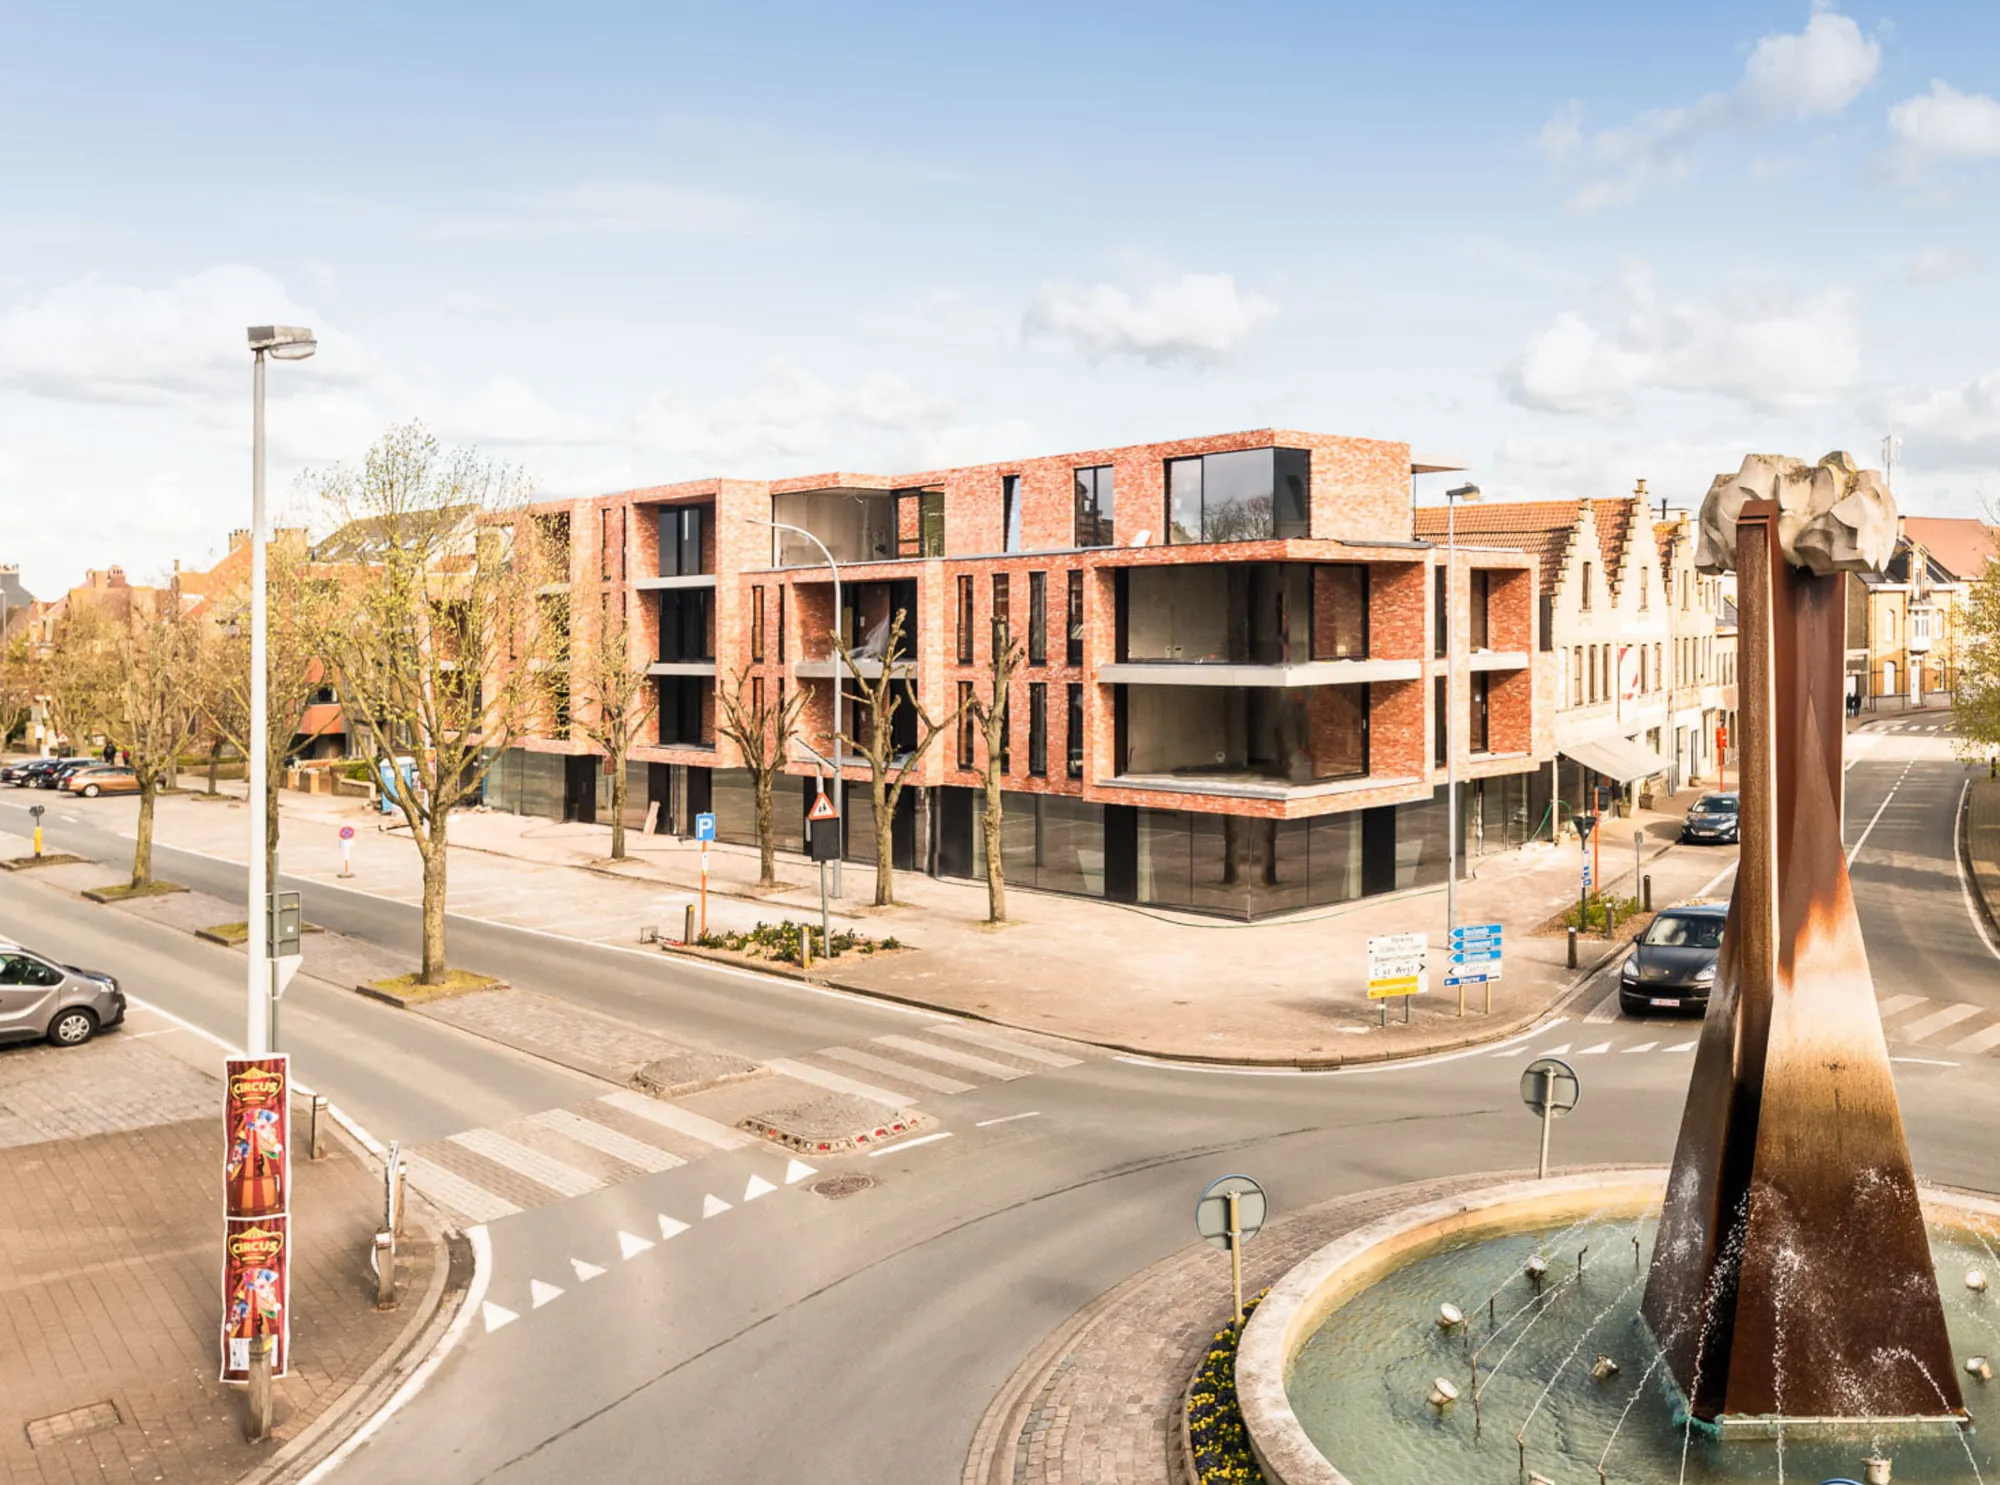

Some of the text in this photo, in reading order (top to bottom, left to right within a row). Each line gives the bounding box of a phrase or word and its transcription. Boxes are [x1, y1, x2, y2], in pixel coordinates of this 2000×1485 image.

[699, 818, 712, 837] P
[233, 1080, 279, 1094] CIRCUS
[232, 1240, 279, 1254] CIRCUS
